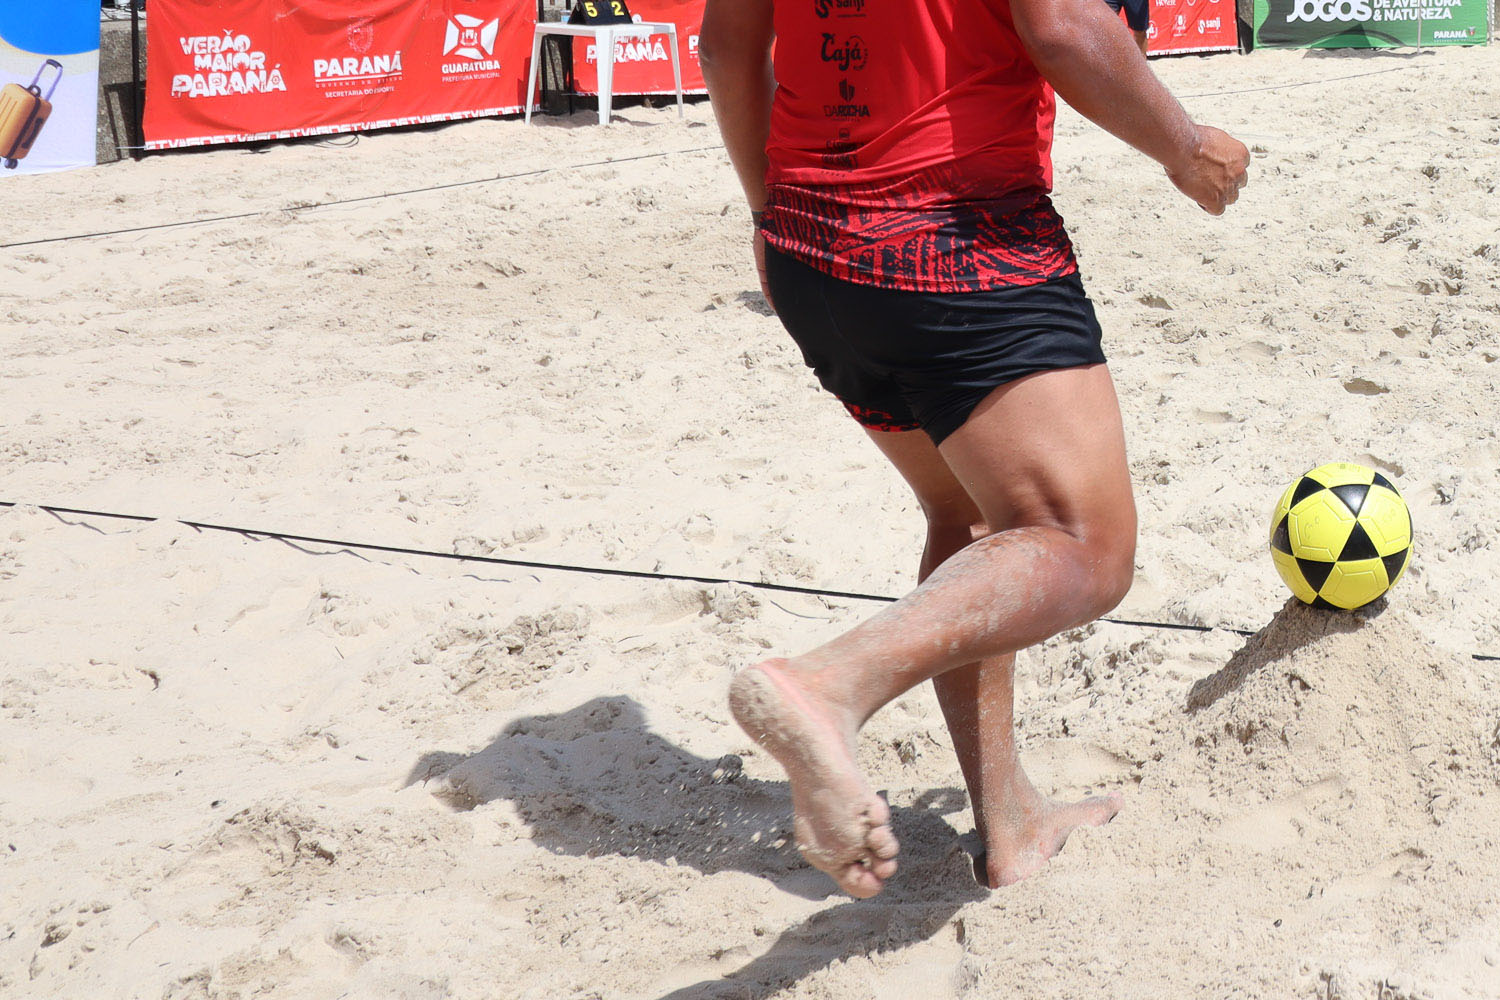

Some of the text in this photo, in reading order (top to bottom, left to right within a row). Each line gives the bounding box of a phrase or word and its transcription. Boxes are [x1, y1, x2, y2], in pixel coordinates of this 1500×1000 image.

[584, 2, 598, 17] 5
[611, 1, 624, 16] 2
[1373, 7, 1453, 21] & NATUREZA
[179, 28, 251, 55] VERÃO
[1433, 29, 1467, 39] PARANÁ
[586, 38, 668, 65] PRANÁ
[821, 33, 862, 71] Cajá
[194, 51, 266, 72] MAIOR
[313, 51, 402, 78] PARANÁ
[441, 60, 501, 74] GUARATUBA
[171, 63, 287, 98] PARANÁ
[441, 72, 501, 83] PREFEITURA MUNICIPAL
[325, 88, 363, 98] SECRETARIA
[364, 88, 373, 96] DO
[823, 105, 871, 117] DAROCHA
